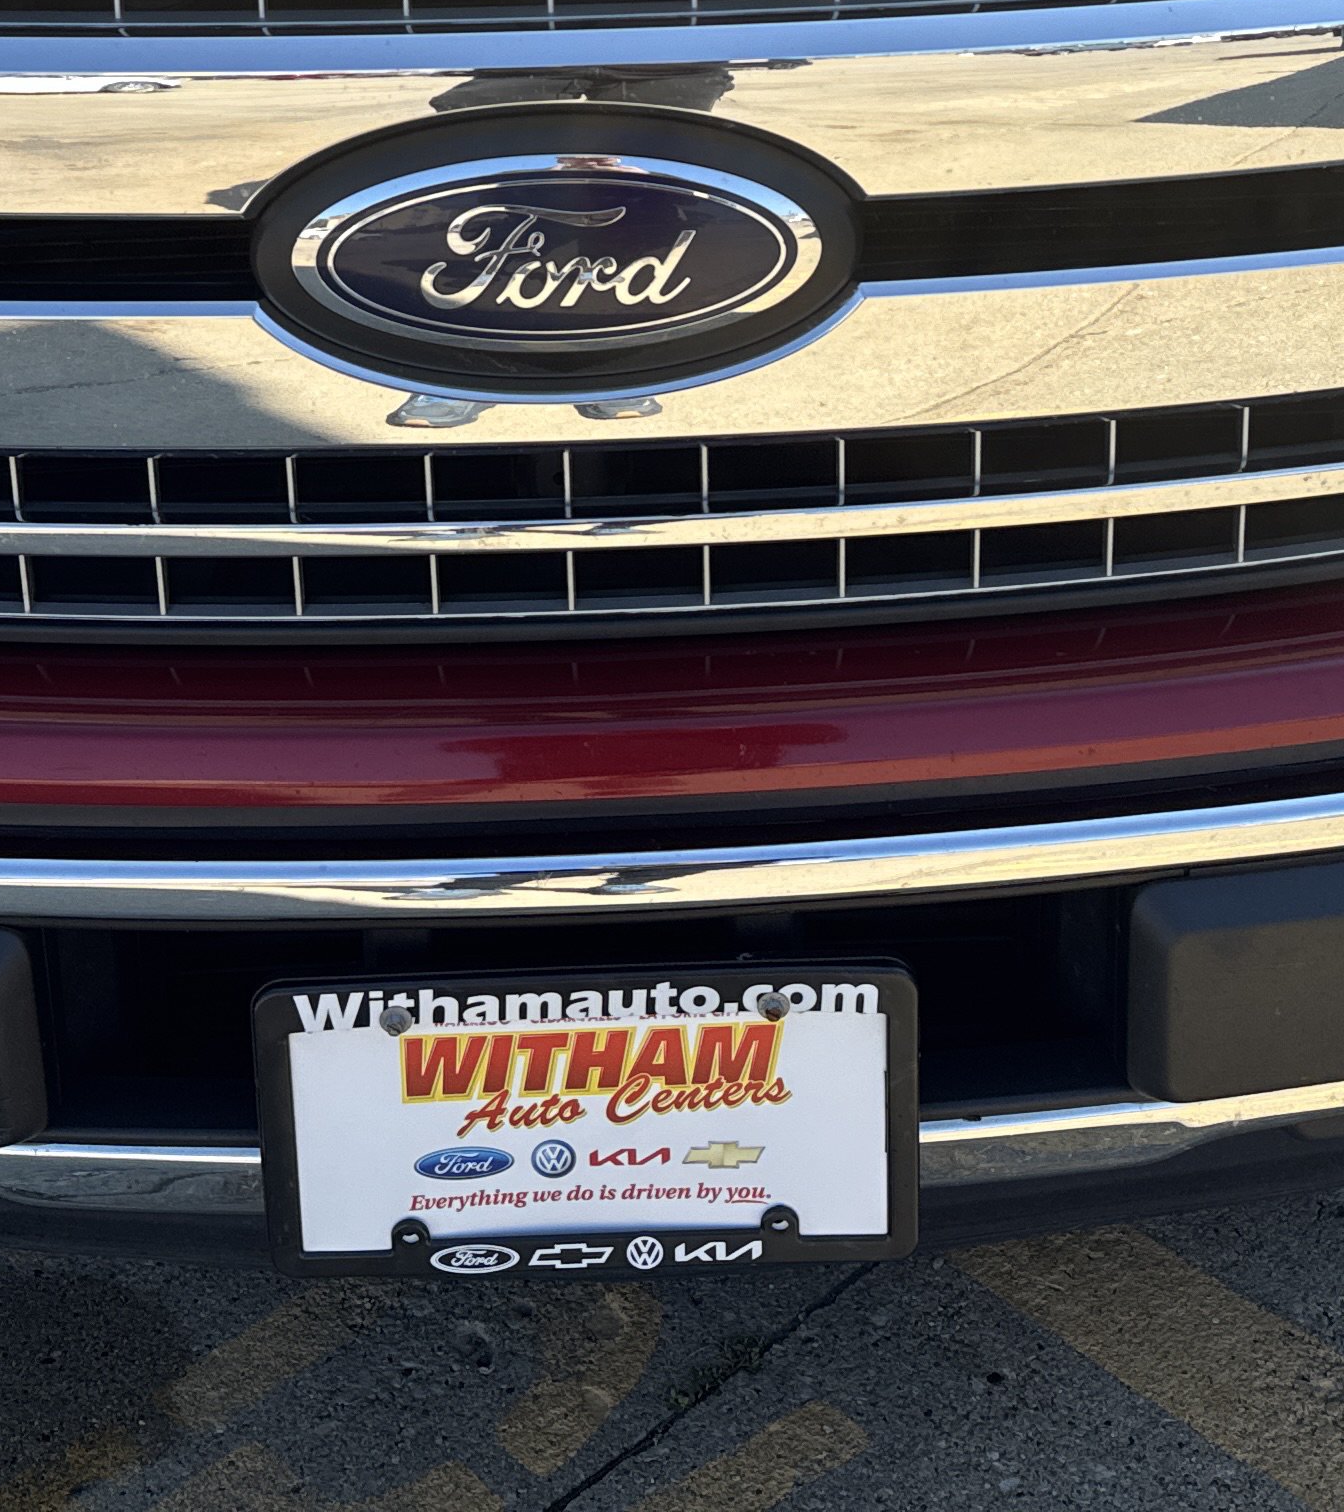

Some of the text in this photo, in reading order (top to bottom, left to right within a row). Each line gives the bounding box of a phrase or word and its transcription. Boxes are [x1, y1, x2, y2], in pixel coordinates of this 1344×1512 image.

[420, 205, 696, 310] Ford
[292, 981, 879, 1033] Withamauto.com
[401, 1021, 783, 1102] WITHAM
[456, 1072, 793, 1138] Auto Centers
[432, 1149, 493, 1175] Ford
[409, 1183, 772, 1212] Everything we do is driven by you.
